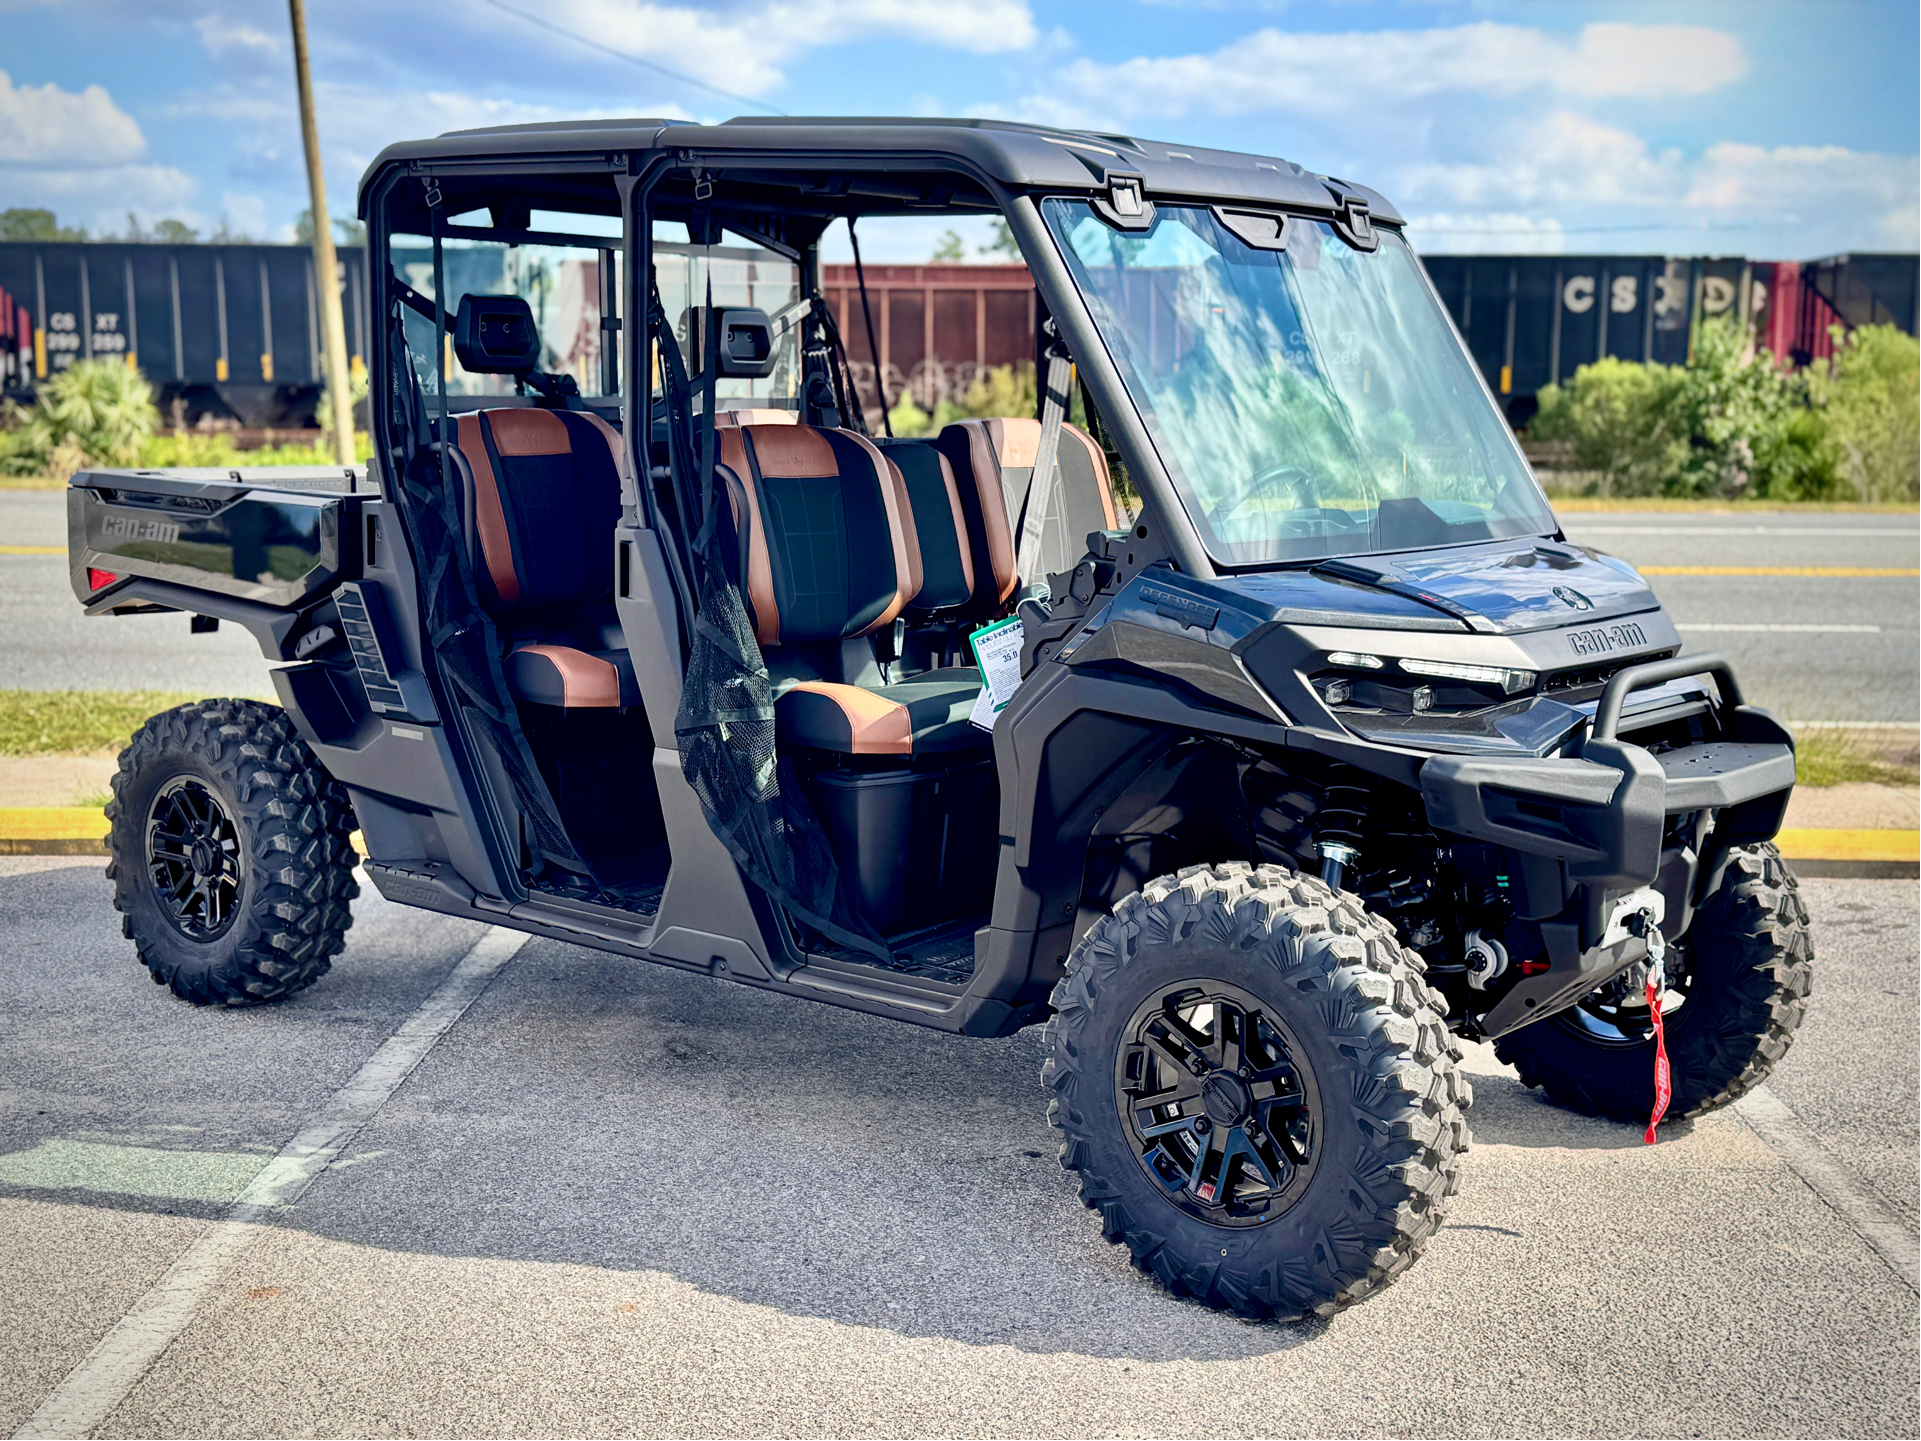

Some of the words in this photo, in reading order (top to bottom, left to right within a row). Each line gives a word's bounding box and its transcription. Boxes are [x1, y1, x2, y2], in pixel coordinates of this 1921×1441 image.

[50, 312, 76, 332] CS
[95, 312, 120, 332] XT
[101, 514, 180, 544] can-am
[1566, 622, 1648, 656] can-am
